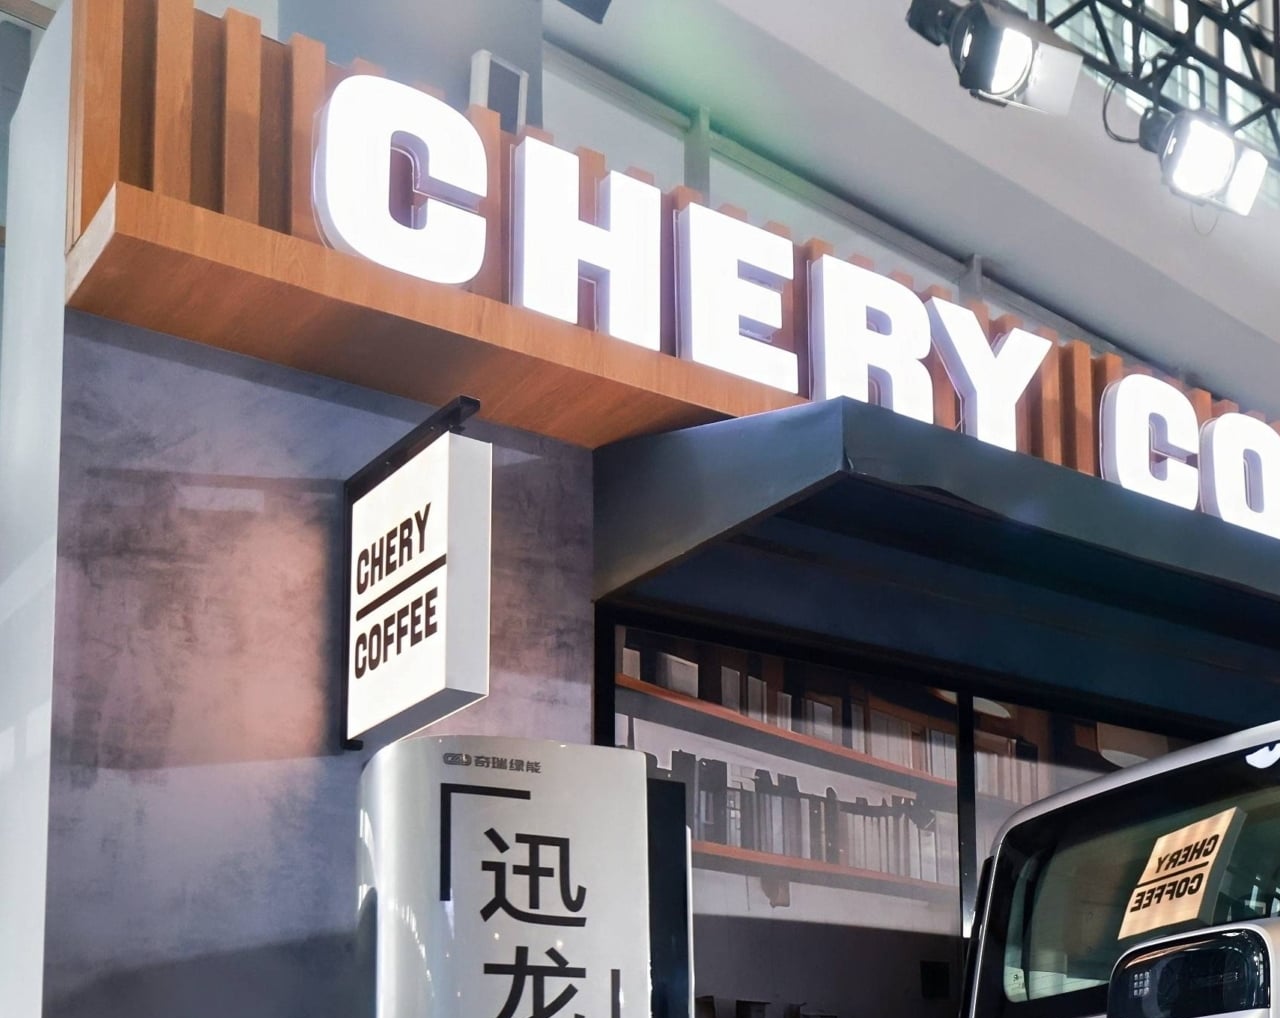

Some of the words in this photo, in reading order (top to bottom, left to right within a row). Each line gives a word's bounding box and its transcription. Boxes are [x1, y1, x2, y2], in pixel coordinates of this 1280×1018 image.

[315, 73, 1053, 452] CHERY
[356, 502, 431, 595] CHERY
[354, 586, 438, 679] COFFEE
